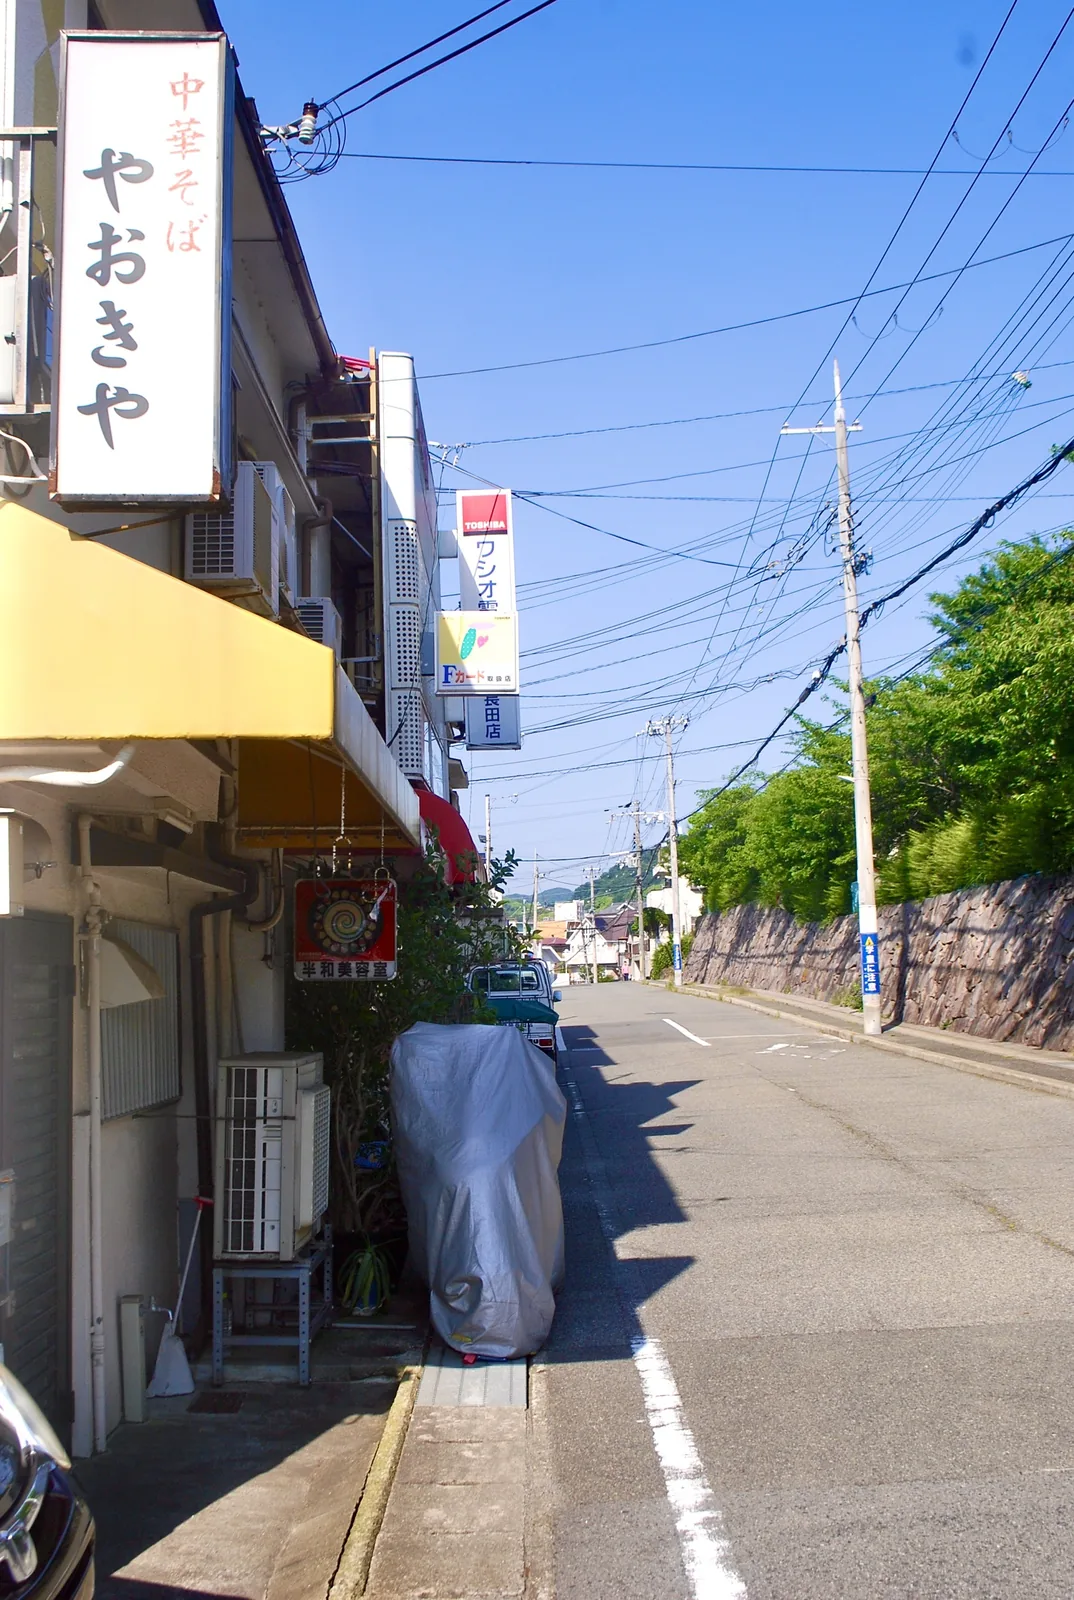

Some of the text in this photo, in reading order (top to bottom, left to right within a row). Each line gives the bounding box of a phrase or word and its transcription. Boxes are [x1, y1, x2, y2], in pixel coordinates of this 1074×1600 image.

[167, 72, 208, 253] 中華そば
[77, 148, 154, 450] やおきや
[464, 520, 505, 530] TOSHIBA
